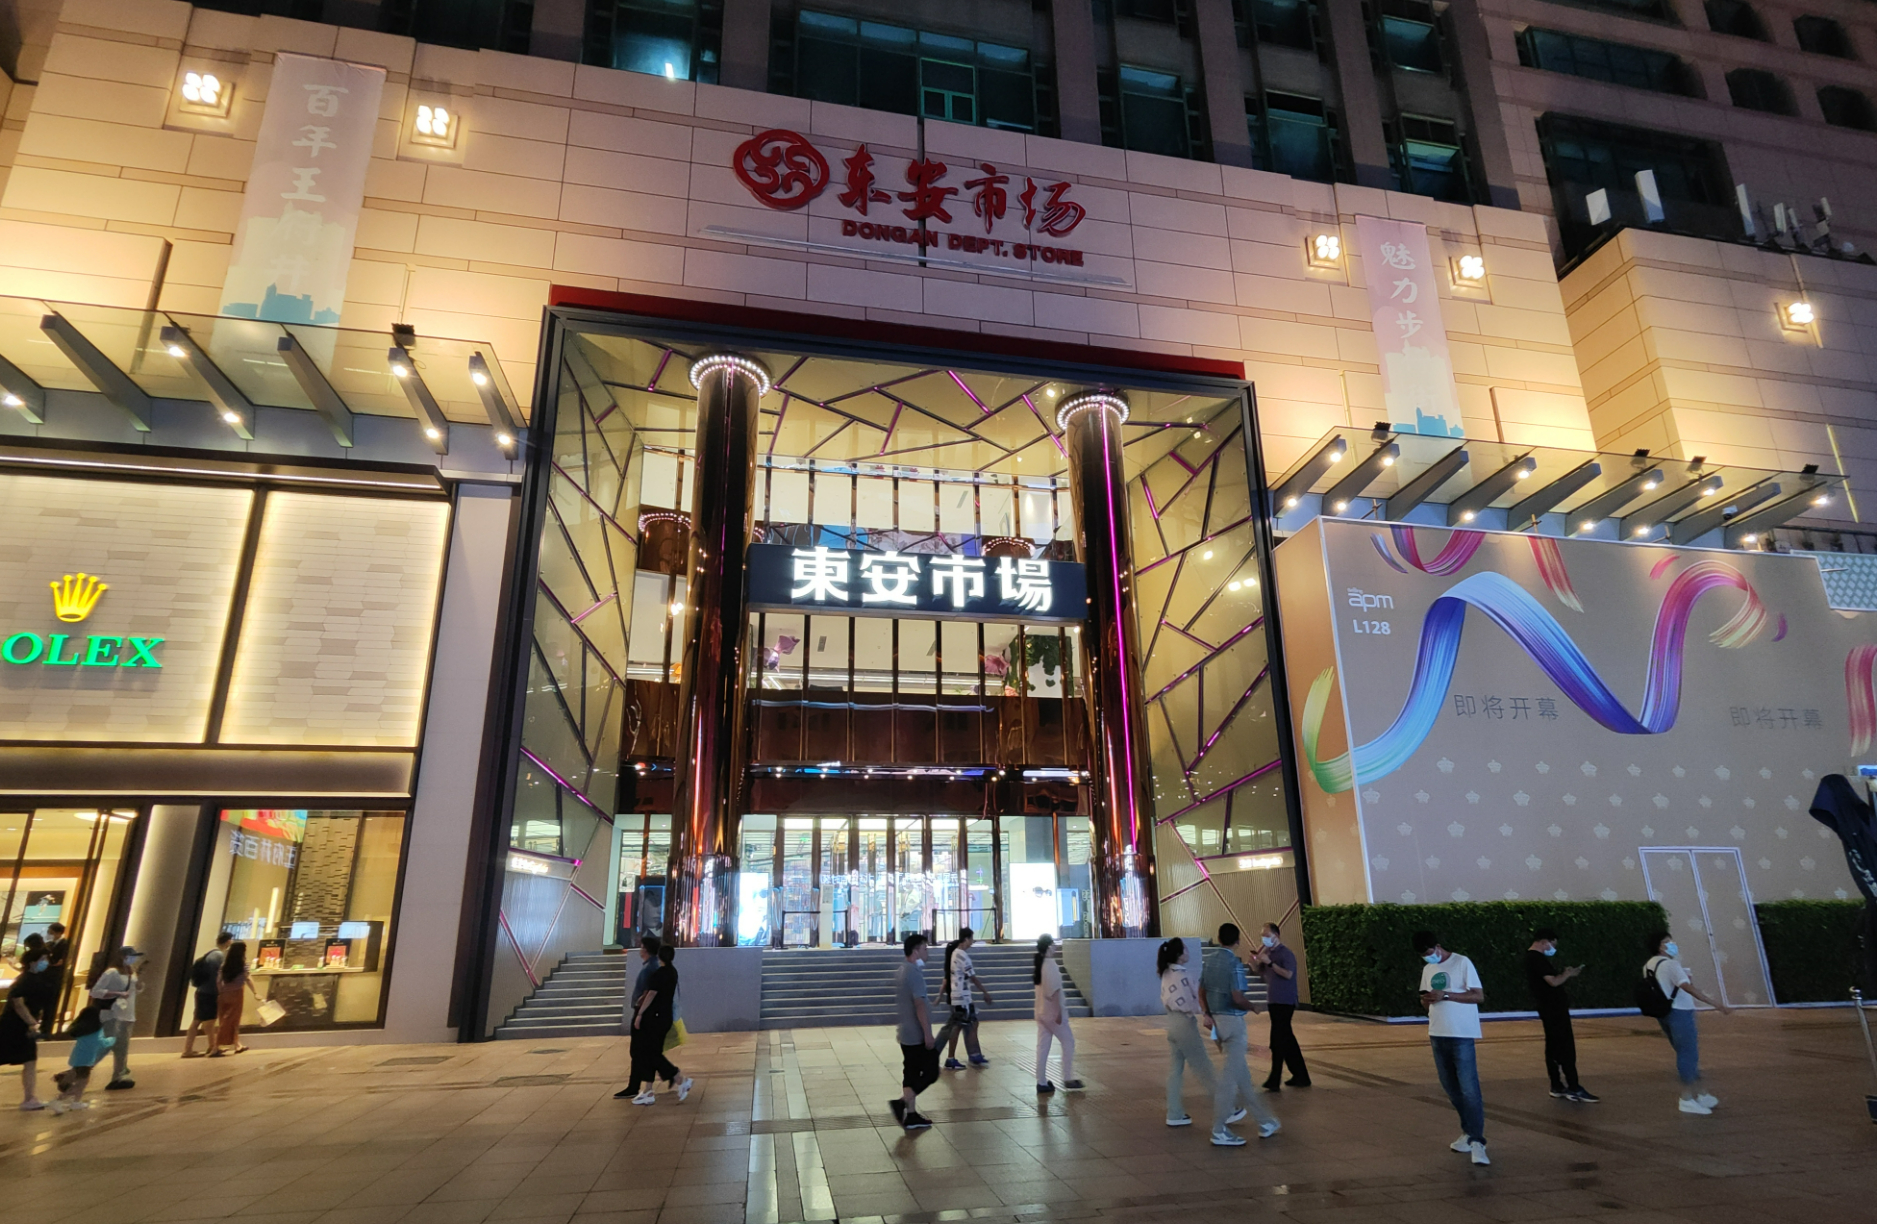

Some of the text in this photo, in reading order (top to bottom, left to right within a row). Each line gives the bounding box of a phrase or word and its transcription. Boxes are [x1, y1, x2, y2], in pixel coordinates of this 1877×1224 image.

[838, 144, 1086, 237] 东安市场
[842, 220, 1084, 266] DONGAN DEPT. STORE
[791, 547, 1052, 611] 東安市場
[1348, 593, 1394, 612] apm
[1353, 619, 1391, 635] L128
[1, 632, 165, 668] OLEX
[1453, 694, 1560, 721] 即将开幕
[1730, 706, 1824, 729] 即将开幕
